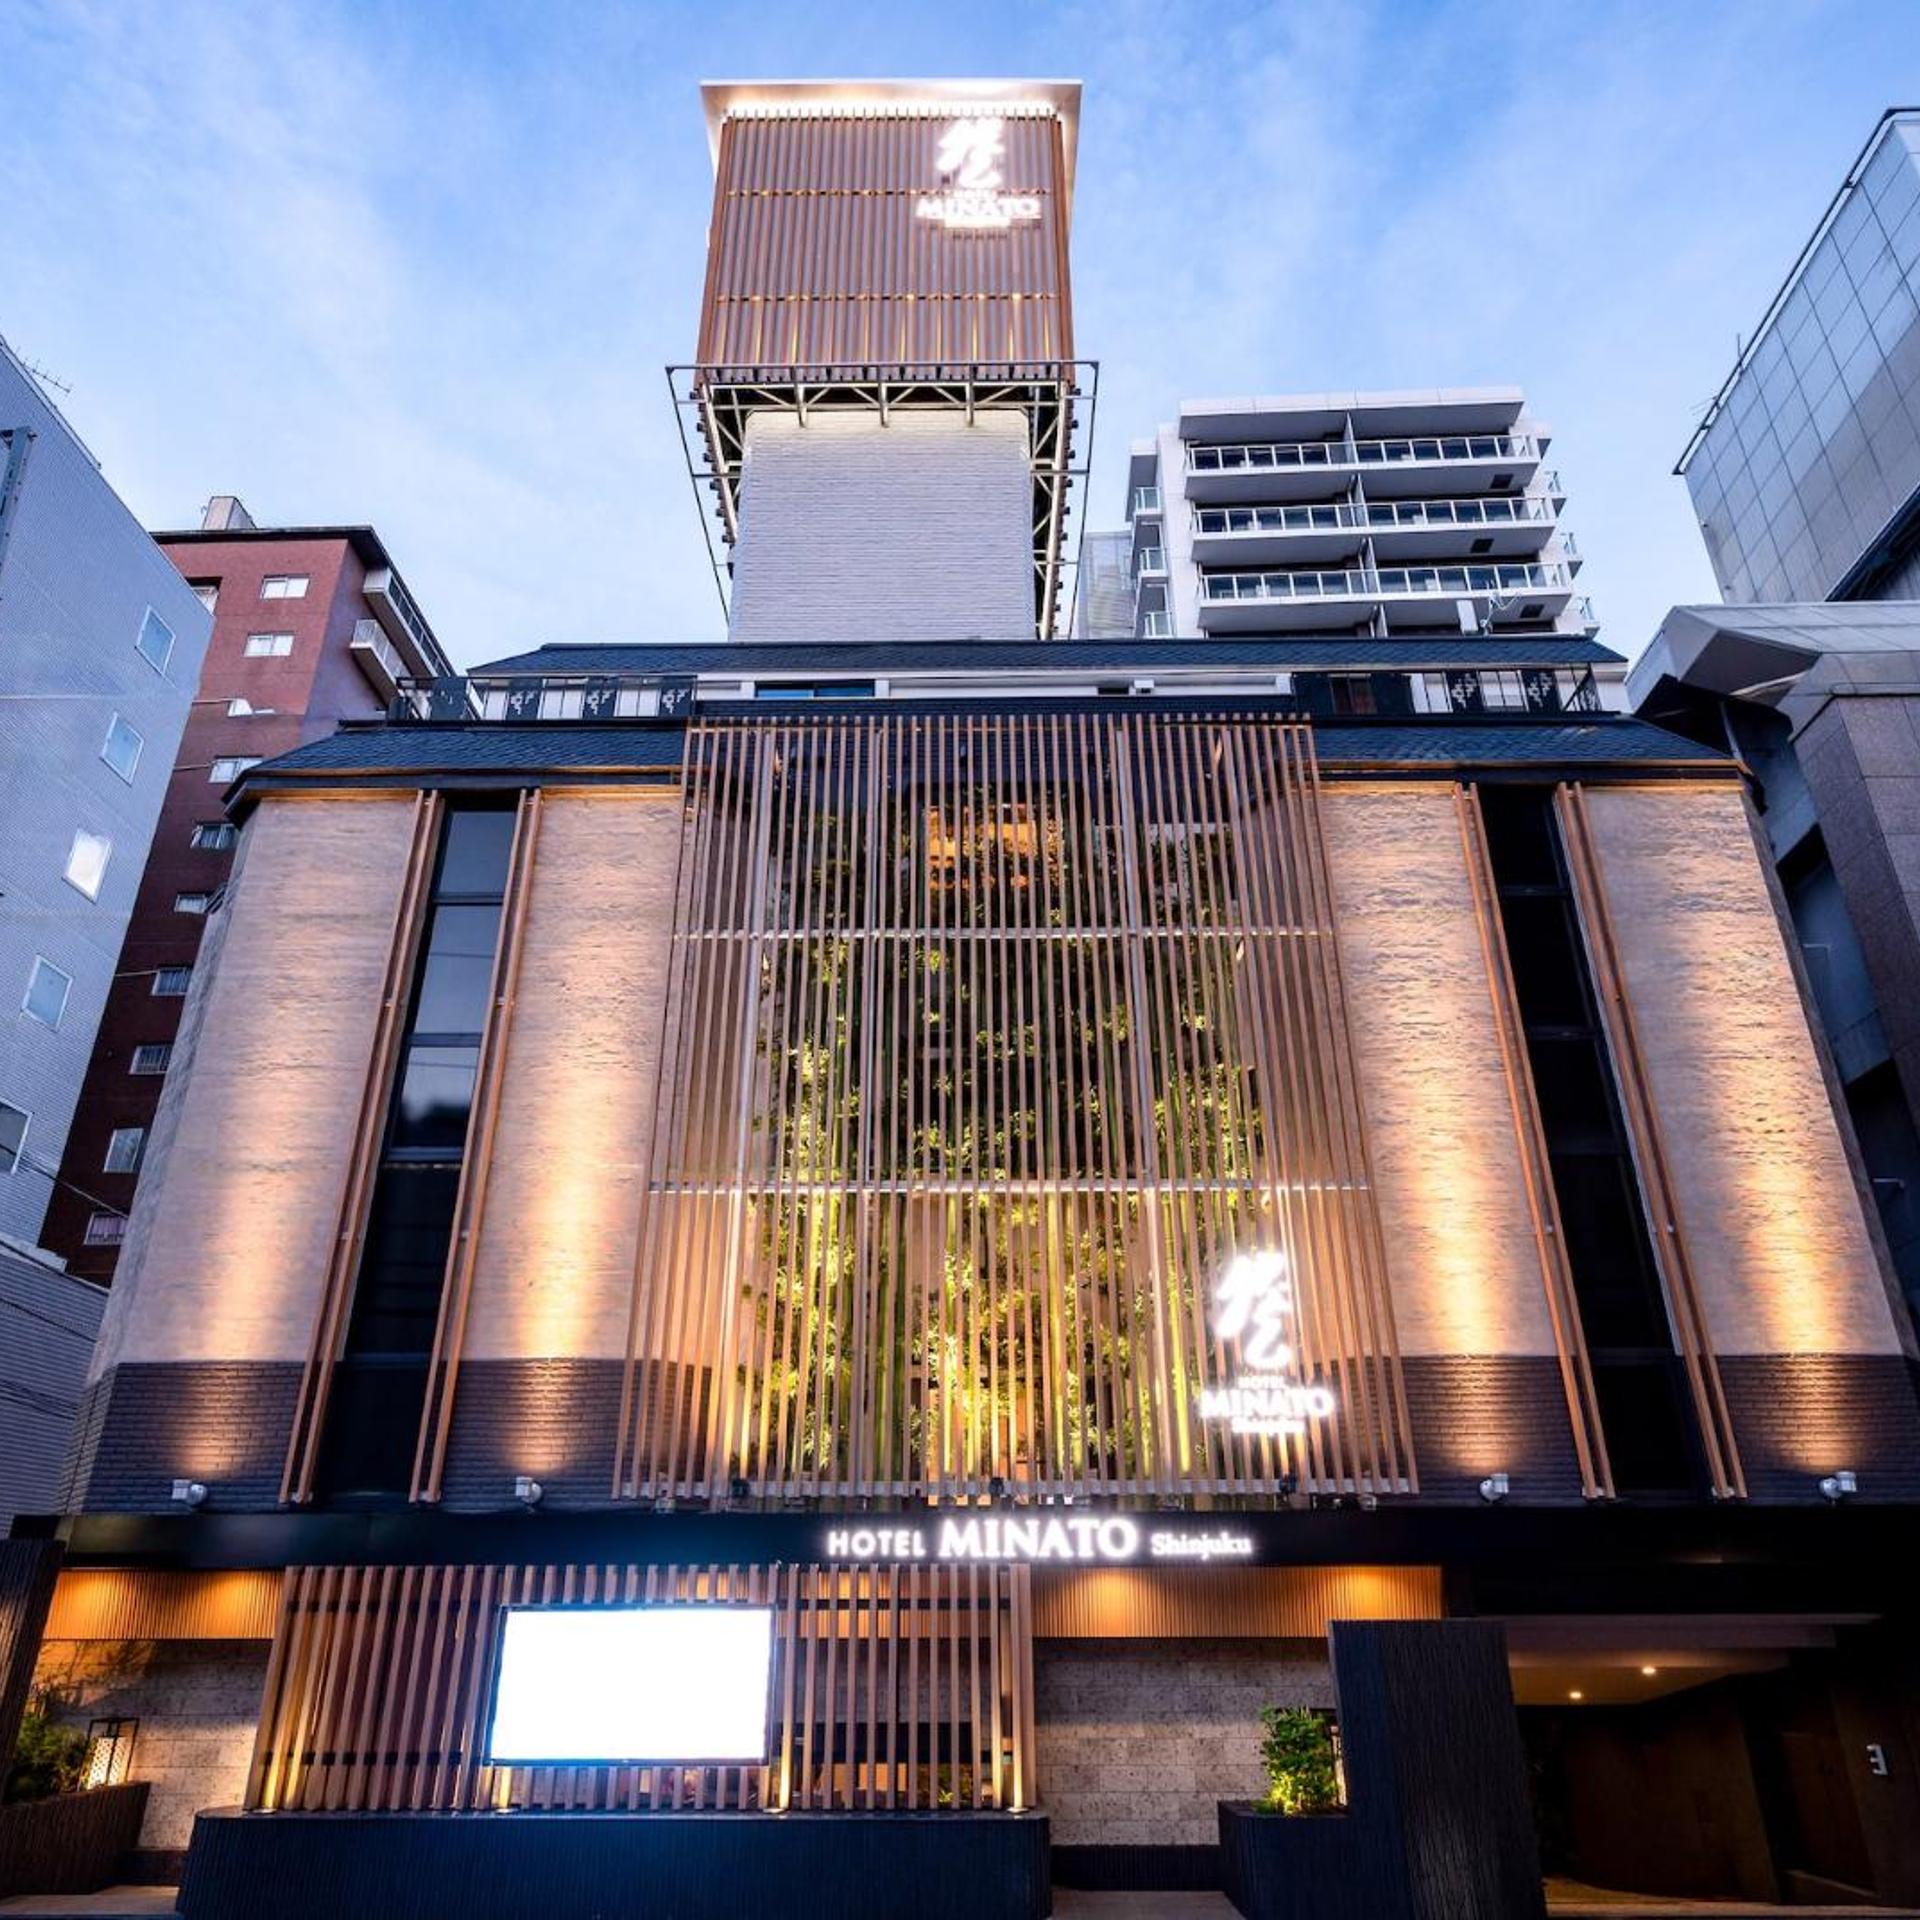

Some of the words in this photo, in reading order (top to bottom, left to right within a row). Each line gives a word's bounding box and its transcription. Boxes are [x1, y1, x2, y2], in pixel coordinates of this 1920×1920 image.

[916, 197, 1040, 217] MINATO
[1200, 1389, 1335, 1417] MINATO
[828, 1530, 926, 1557] HOTEL
[938, 1518, 1138, 1559] MINATO
[1151, 1532, 1252, 1560] Shinjuku
